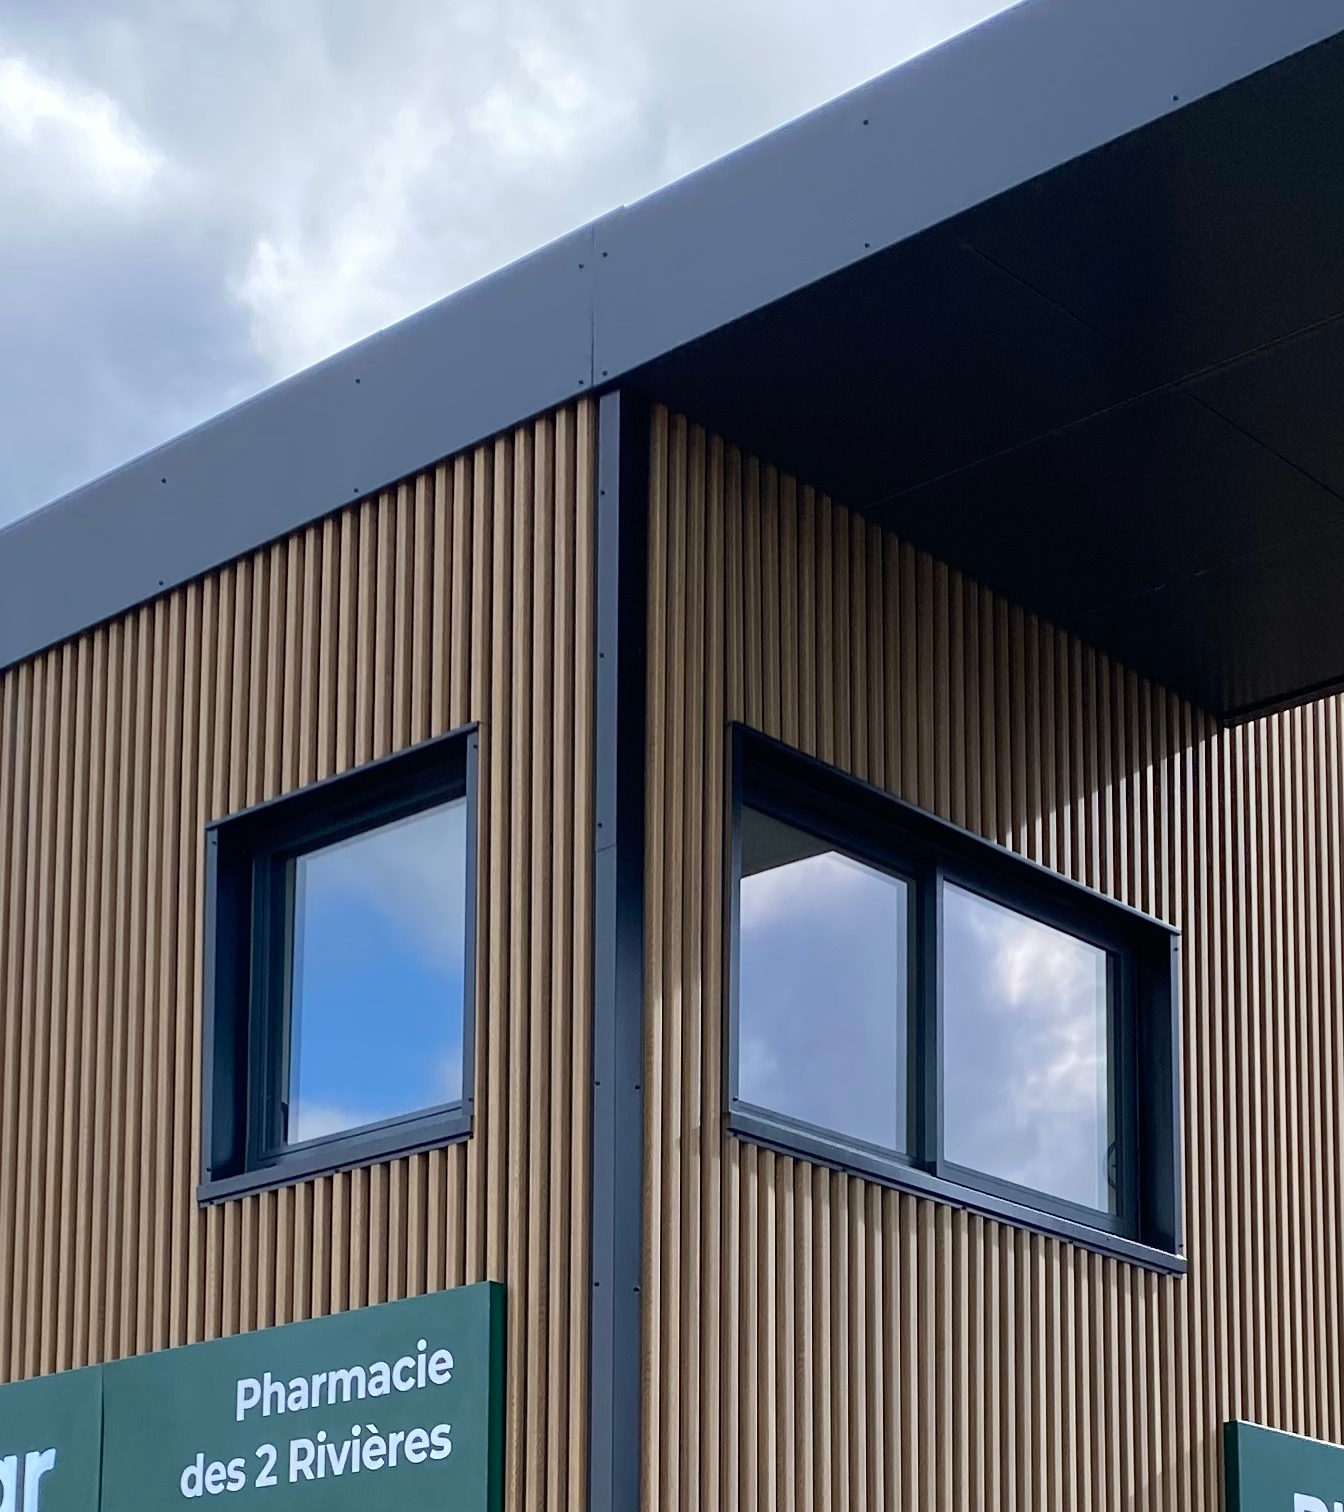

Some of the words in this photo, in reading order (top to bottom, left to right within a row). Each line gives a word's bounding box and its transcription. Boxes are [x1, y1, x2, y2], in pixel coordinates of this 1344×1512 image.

[236, 1339, 453, 1421] Pharmacie
[180, 1453, 246, 1498] des
[255, 1444, 278, 1487] 2
[289, 1422, 453, 1483] Rivières
